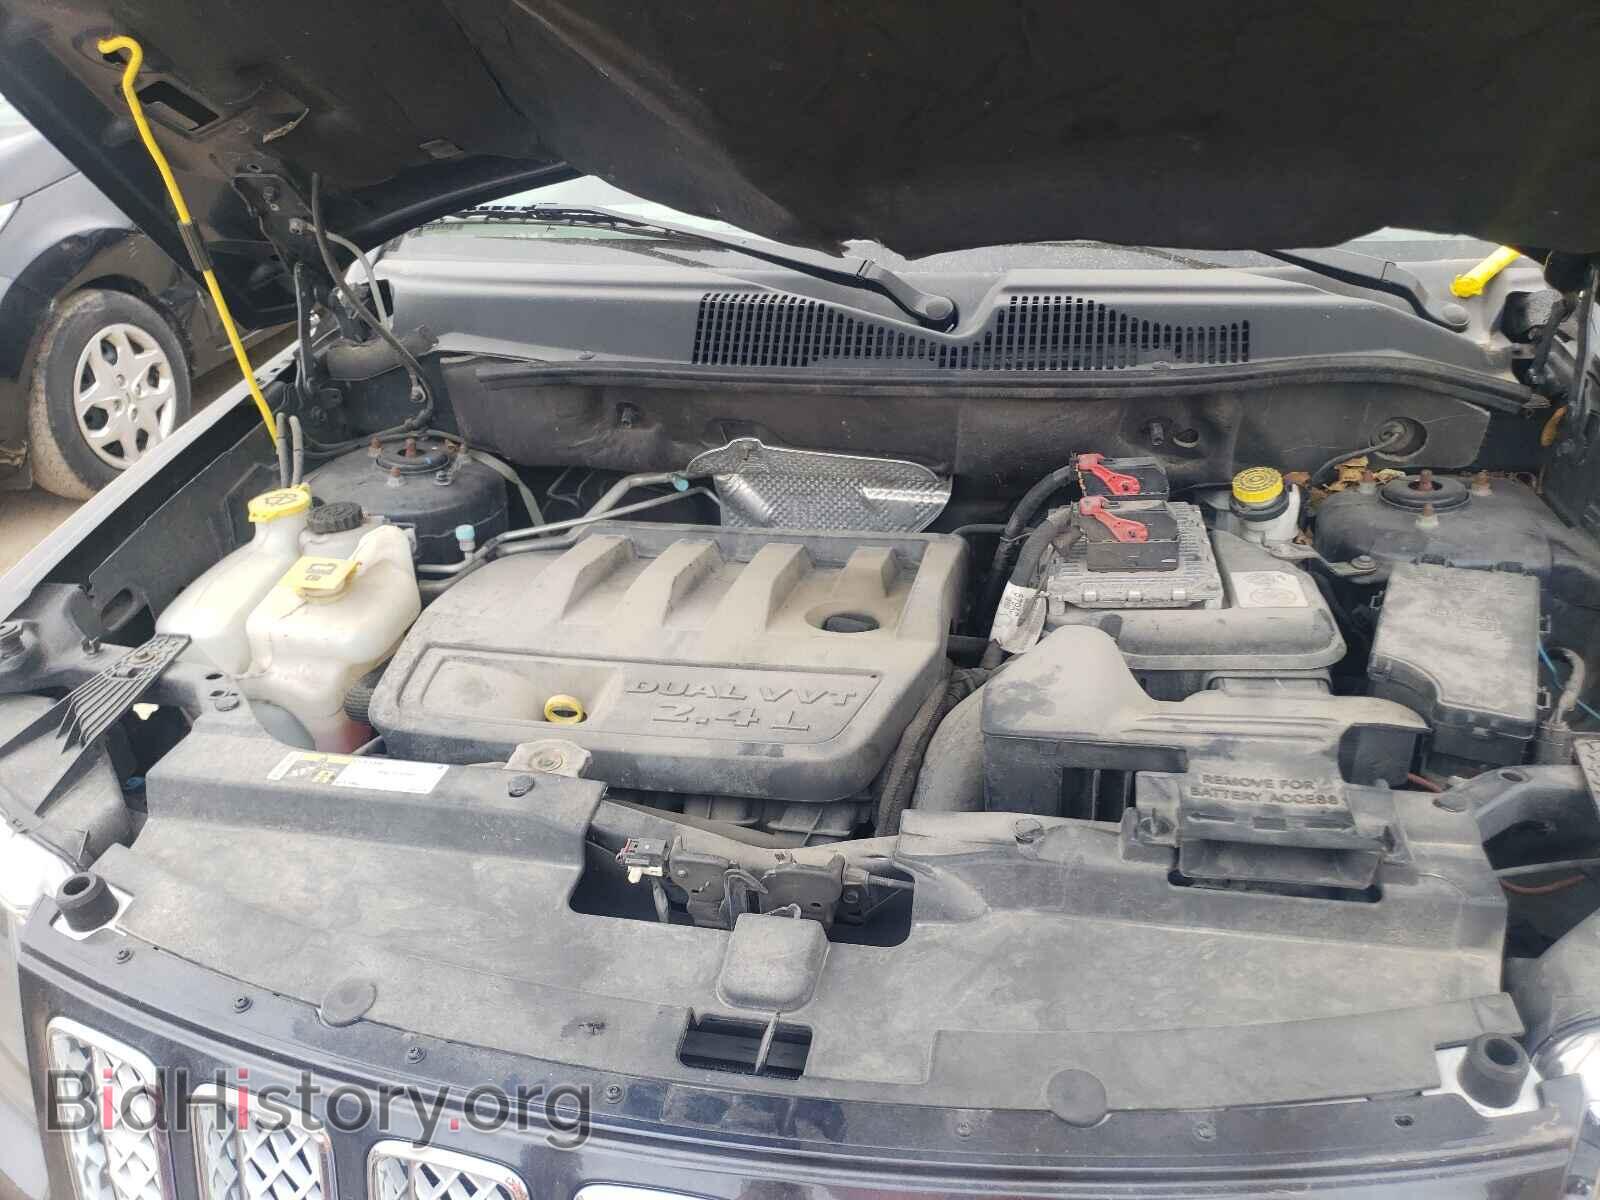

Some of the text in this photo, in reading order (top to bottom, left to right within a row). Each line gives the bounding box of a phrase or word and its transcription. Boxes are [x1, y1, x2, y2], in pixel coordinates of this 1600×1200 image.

[624, 679, 857, 706] DUAL VVT
[652, 703, 810, 732] 2.4L
[1201, 773, 1316, 791] REMOVE FOR
[1190, 786, 1340, 806] BATTERY ACCESS
